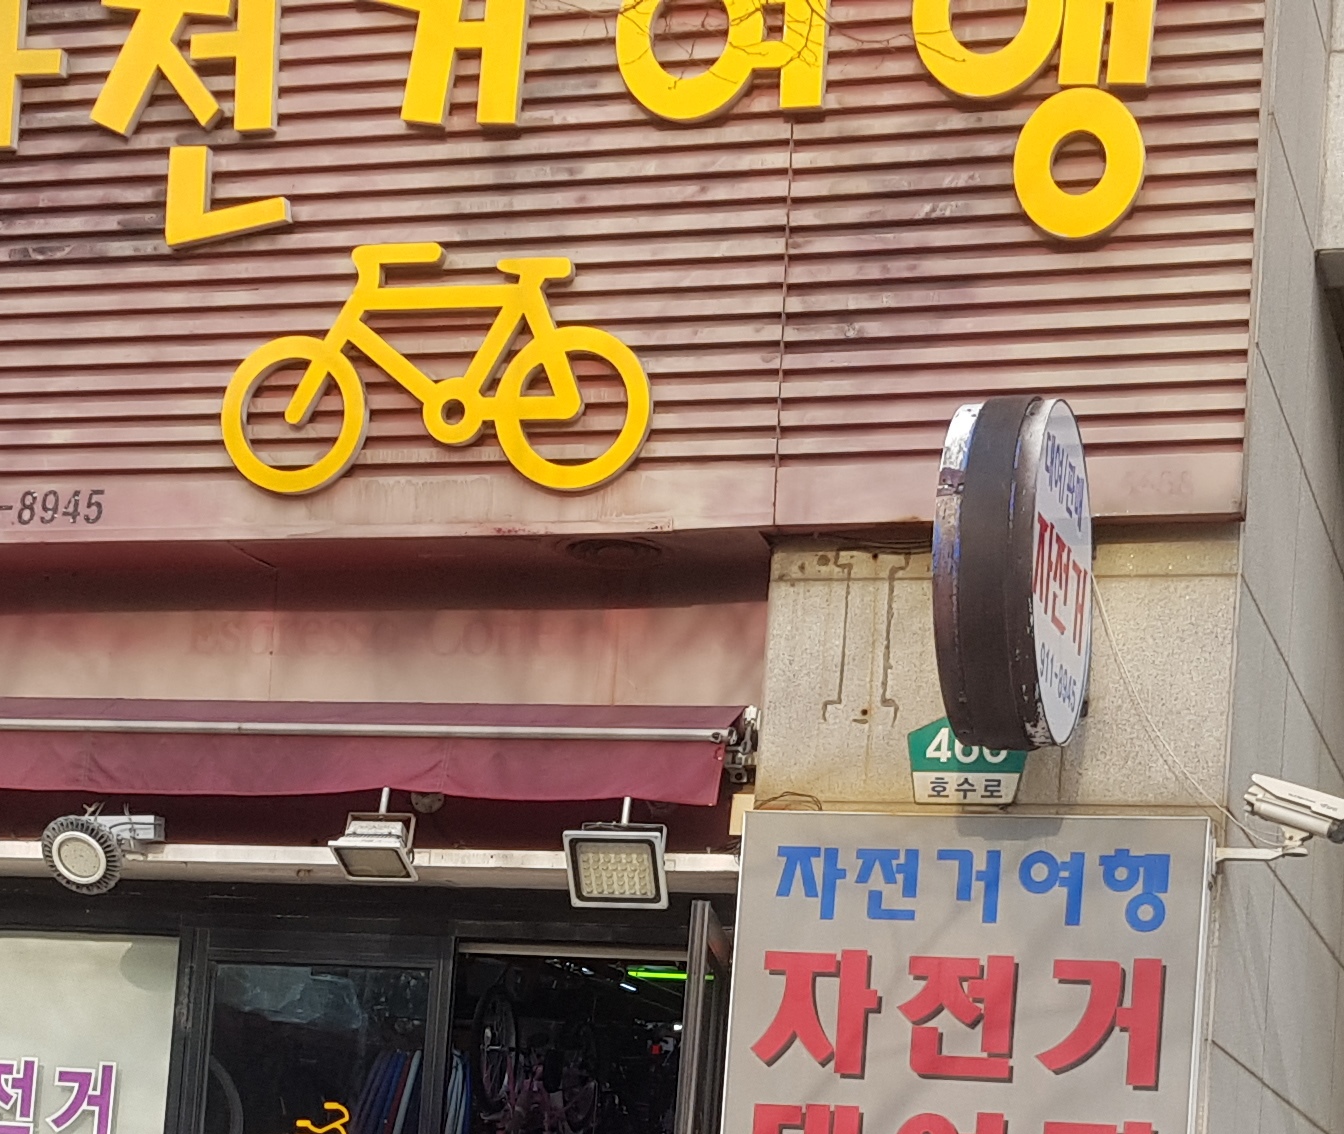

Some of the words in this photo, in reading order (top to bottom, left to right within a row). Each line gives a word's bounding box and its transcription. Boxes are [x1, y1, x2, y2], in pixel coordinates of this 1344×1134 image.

[1032, 511, 1089, 657] 자전거
[1039, 641, 1078, 713] 911-8945
[927, 776, 1003, 800] 호수로
[775, 845, 1172, 933] 자전거여행
[750, 949, 1165, 1090] 자전거
